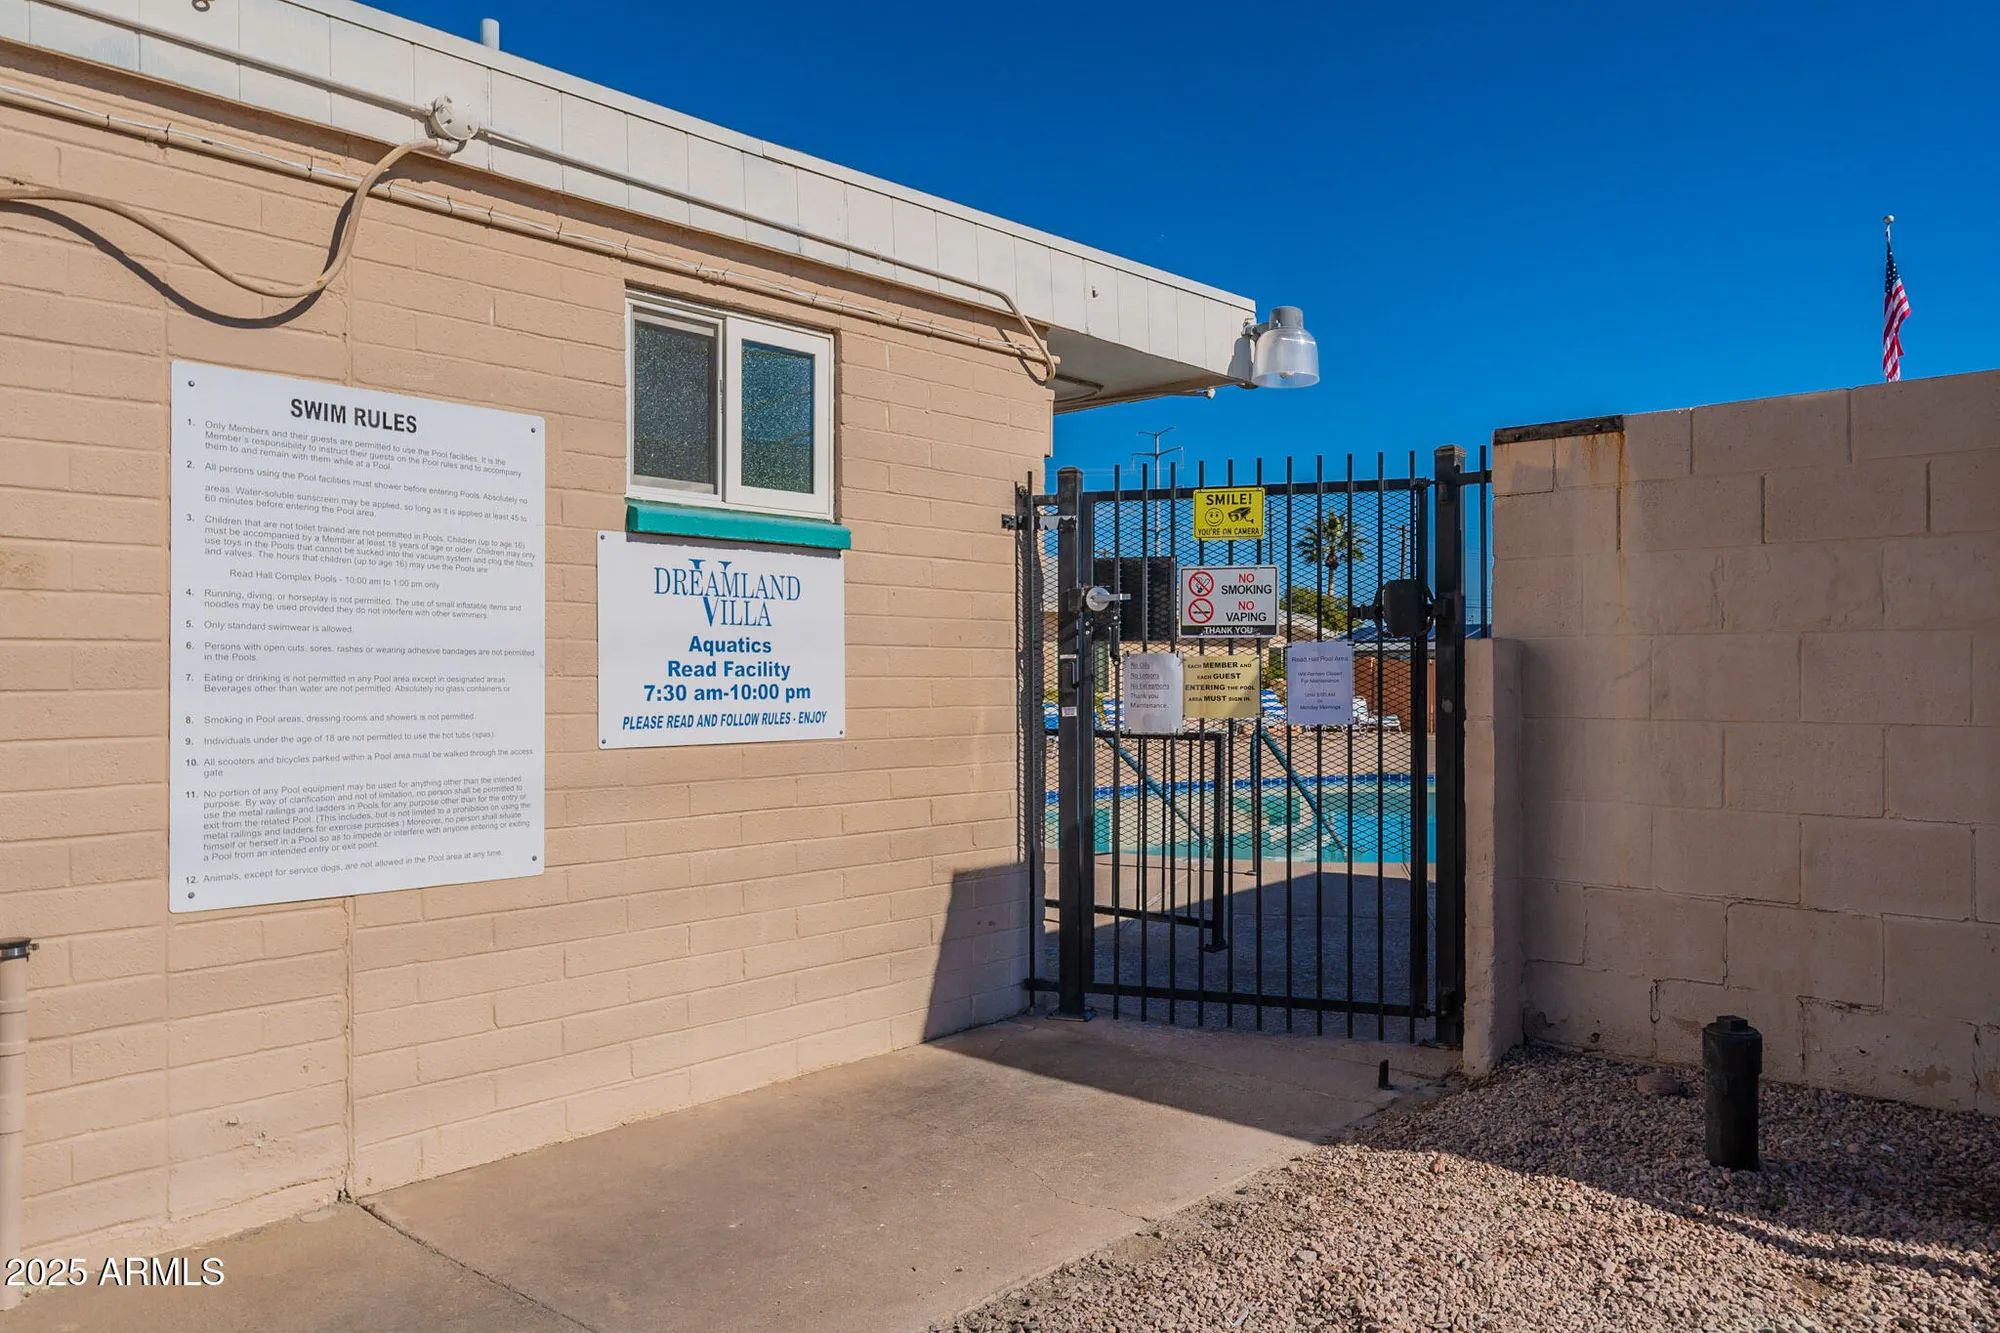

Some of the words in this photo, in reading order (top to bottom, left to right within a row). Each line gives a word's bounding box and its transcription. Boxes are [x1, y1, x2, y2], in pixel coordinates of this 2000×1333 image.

[291, 398, 346, 424] SWIM
[354, 407, 417, 433] RULES
[204, 420, 226, 431] Only
[228, 423, 269, 435] Members
[271, 428, 288, 437] and
[289, 431, 308, 440] their
[310, 433, 337, 445] guests
[354, 439, 391, 452] permitted
[417, 447, 429, 455] the
[431, 449, 448, 458] Pool
[204, 440, 228, 450] them
[240, 445, 258, 454] and
[259, 447, 289, 458] remain
[291, 451, 308, 460] with
[310, 453, 331, 462] them
[333, 456, 354, 465] while
[251, 436, 306, 451] responsibility
[318, 444, 348, 455] instruct
[349, 448, 367, 457] their
[369, 451, 395, 462] guests
[408, 455, 420, 464] the
[421, 457, 439, 466] Pool
[440, 460, 457, 468] rules
[459, 462, 473, 470] and
[482, 467, 522, 478] accompany
[1206, 493, 1252, 505] SMILE!
[228, 569, 253, 577] Read
[255, 570, 273, 578] Hall
[274, 571, 311, 582] Complex
[313, 573, 337, 582] Pools
[345, 575, 367, 583] 10:00
[424, 580, 440, 589] only
[654, 559, 801, 600] DREAMLAND
[1239, 573, 1255, 583] NO
[1221, 585, 1272, 594] SMOKING
[702, 597, 772, 627] VILLA
[1238, 601, 1255, 610] NO
[203, 620, 225, 630] Only
[227, 621, 266, 629] standard
[267, 622, 310, 631] swimwear
[1226, 612, 1267, 622] VAPING
[689, 636, 772, 656] Aquatics
[667, 660, 717, 677] Read
[724, 661, 791, 680] Facility
[643, 684, 687, 701] 7:30
[694, 684, 779, 700] am-10:00
[785, 686, 811, 703] pm
[203, 715, 243, 724] Smoking
[306, 714, 341, 723] dressing
[622, 715, 664, 730] PLEASE
[666, 715, 695, 729] READ
[696, 714, 718, 728] AND
[720, 712, 759, 727] FOLLOW
[762, 712, 791, 725] RULES
[798, 711, 827, 724] ENJOY
[185, 875, 198, 883] 12.
[202, 872, 241, 883] Animals,
[243, 869, 273, 880] except
[274, 867, 286, 876] for
[288, 865, 318, 874] service
[320, 862, 343, 873] dogs,
[374, 857, 403, 866] allowed
[427, 853, 444, 861] Pool
